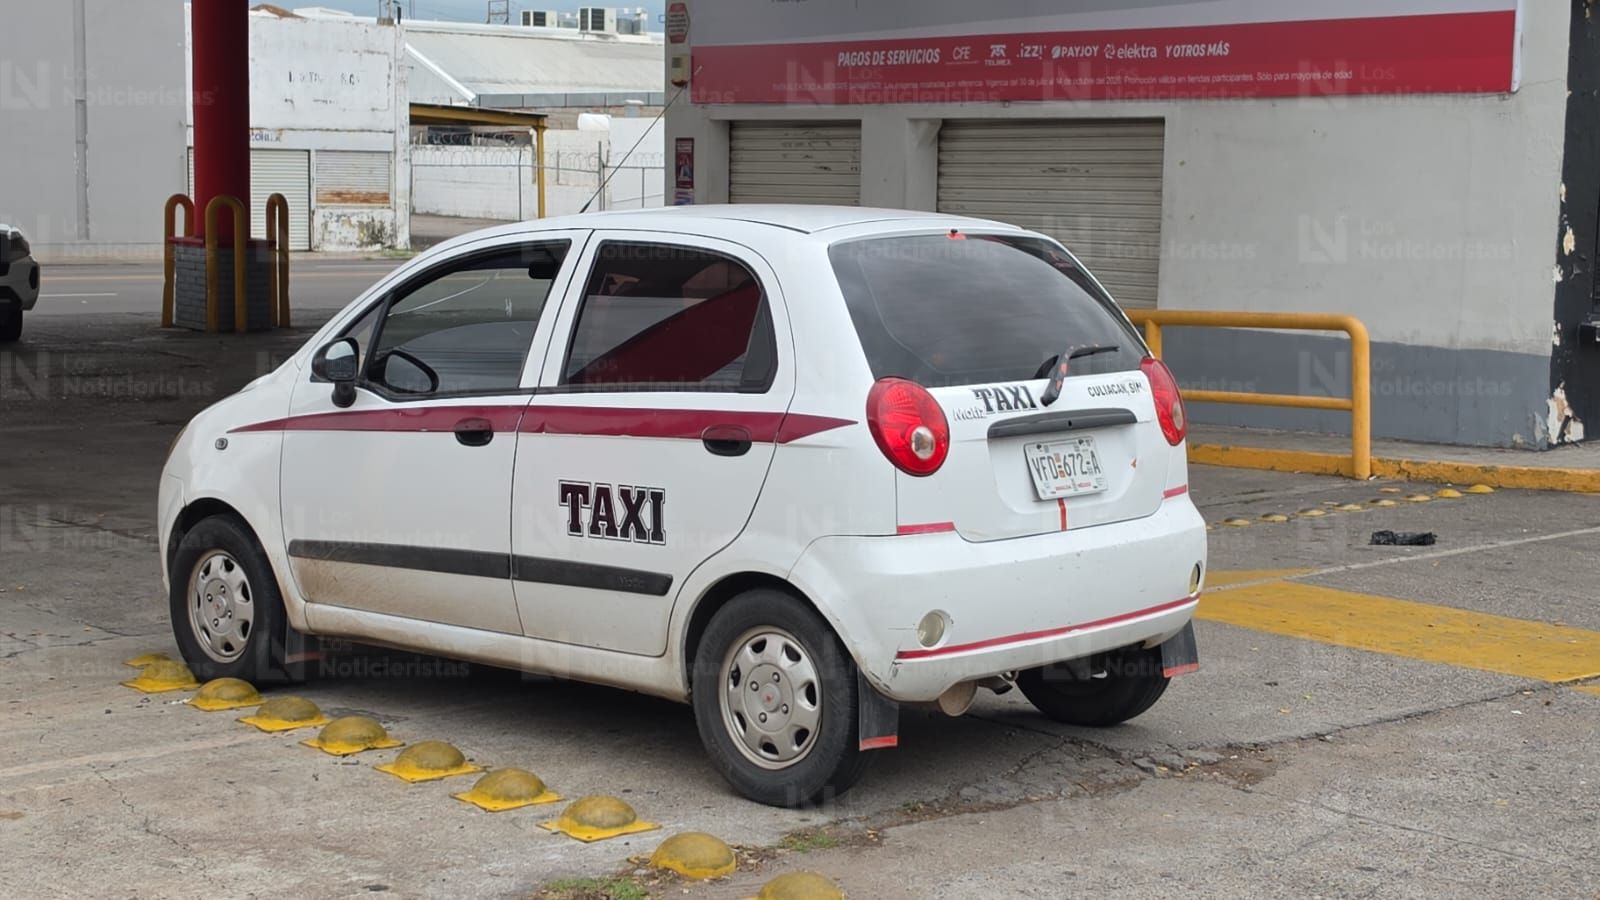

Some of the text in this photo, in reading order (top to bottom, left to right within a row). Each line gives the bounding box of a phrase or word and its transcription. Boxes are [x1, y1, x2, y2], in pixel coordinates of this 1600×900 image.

[837, 48, 941, 67] PAGOS DE SERVICIOS
[952, 46, 971, 60] CFE
[1061, 45, 1099, 58] PAYJOY
[1117, 43, 1157, 59] elektra
[1165, 40, 1230, 58] Y OTROS MÁS
[972, 385, 1038, 414] TAXI
[1031, 449, 1101, 482] YFD-672-A
[558, 479, 666, 546] TAXI
